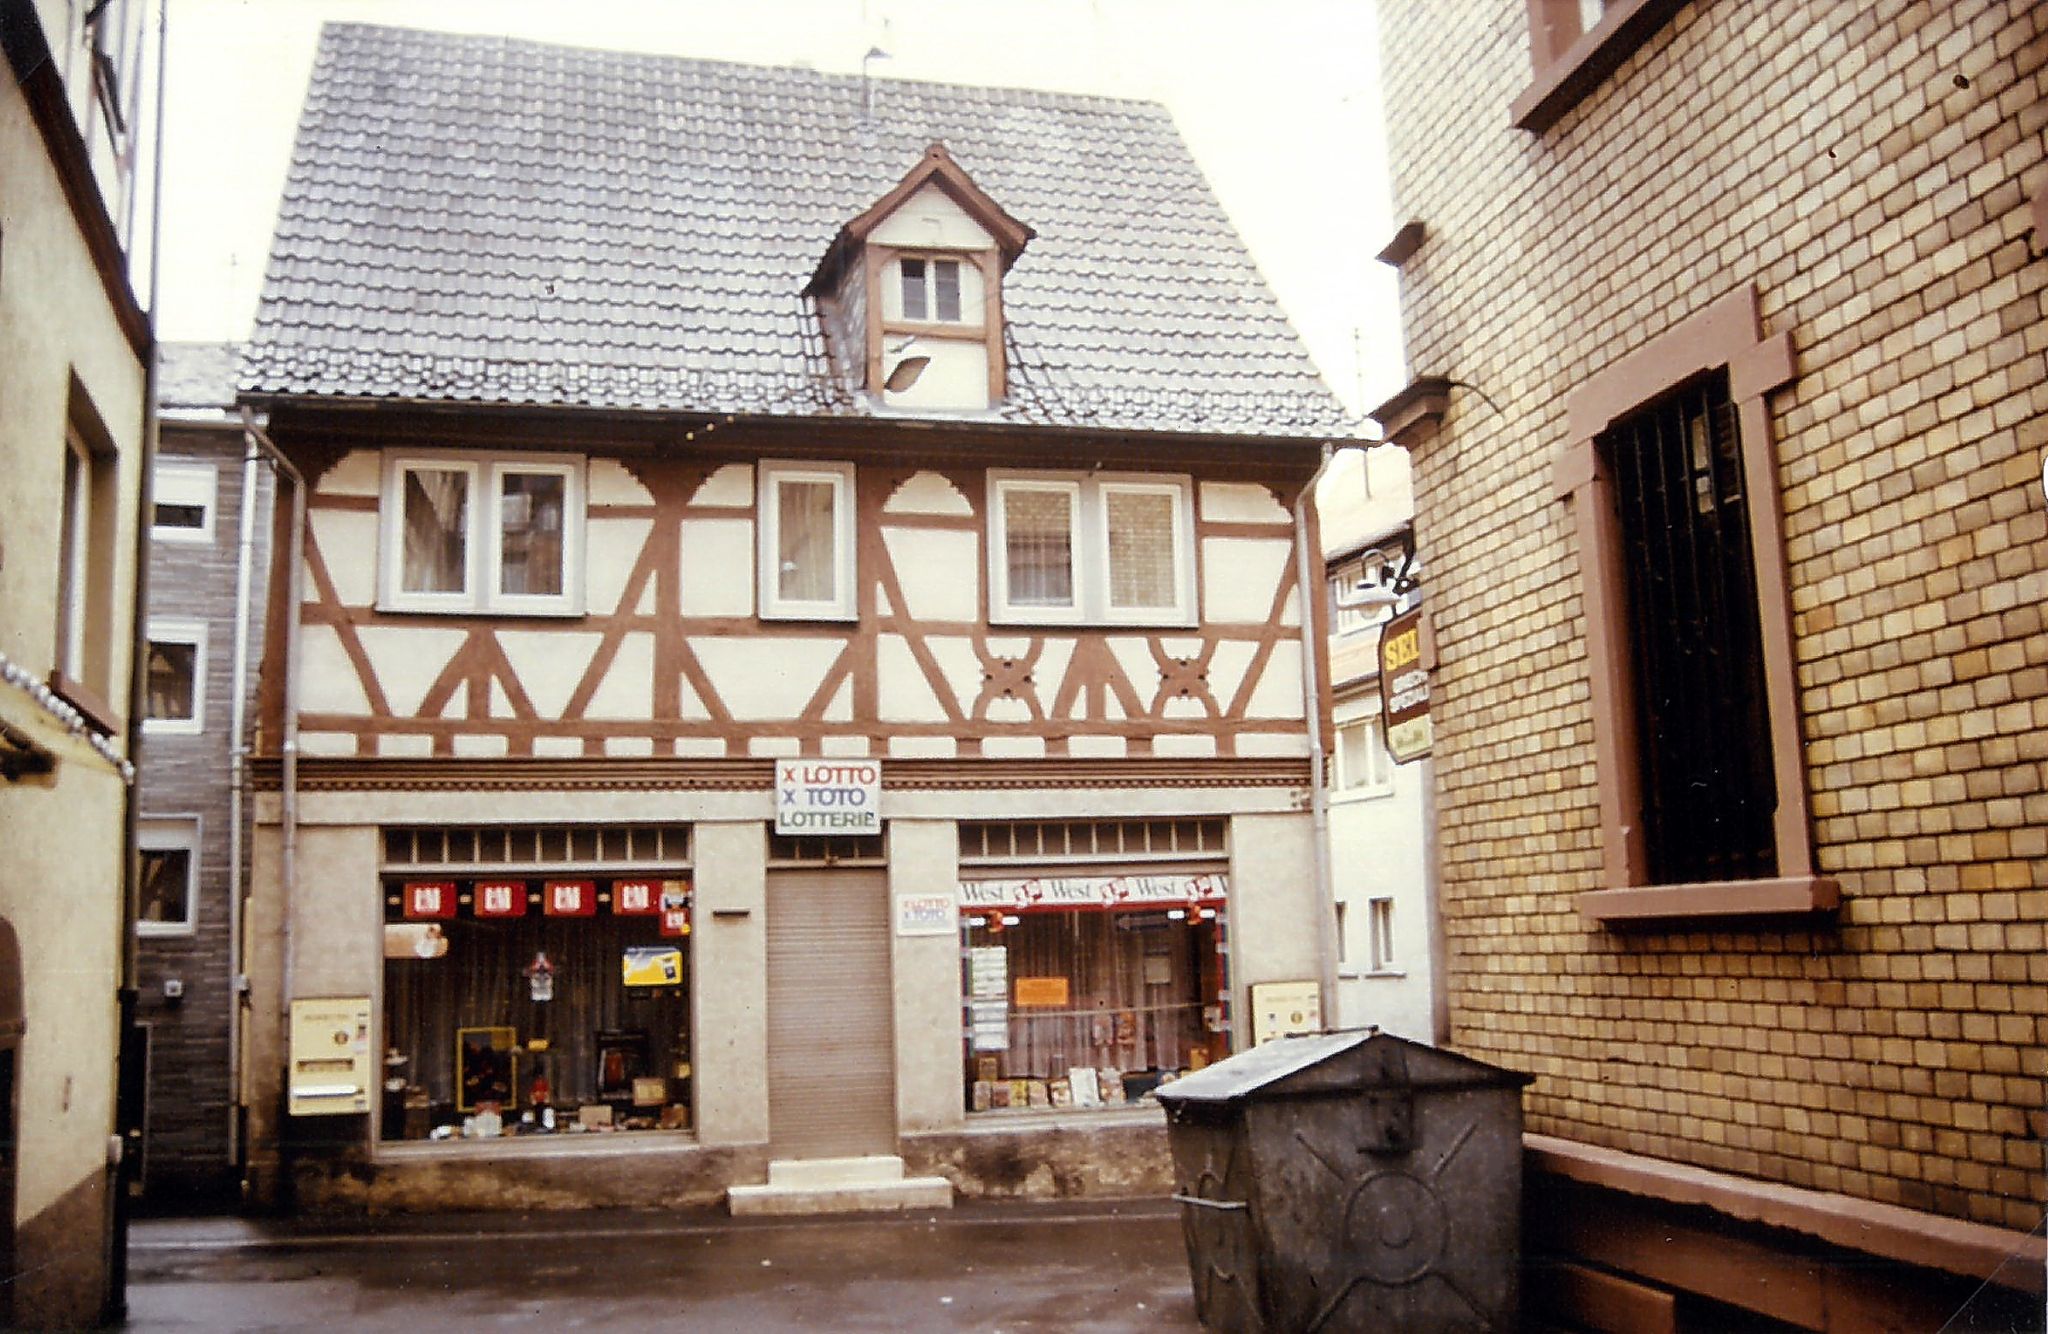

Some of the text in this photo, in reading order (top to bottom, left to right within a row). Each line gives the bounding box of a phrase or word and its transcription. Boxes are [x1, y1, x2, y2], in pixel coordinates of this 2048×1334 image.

[783, 766, 877, 785] X LOTTO
[783, 787, 866, 806] X TOTO
[780, 811, 875, 828] LOTTERIE
[962, 878, 1176, 901] West West West
